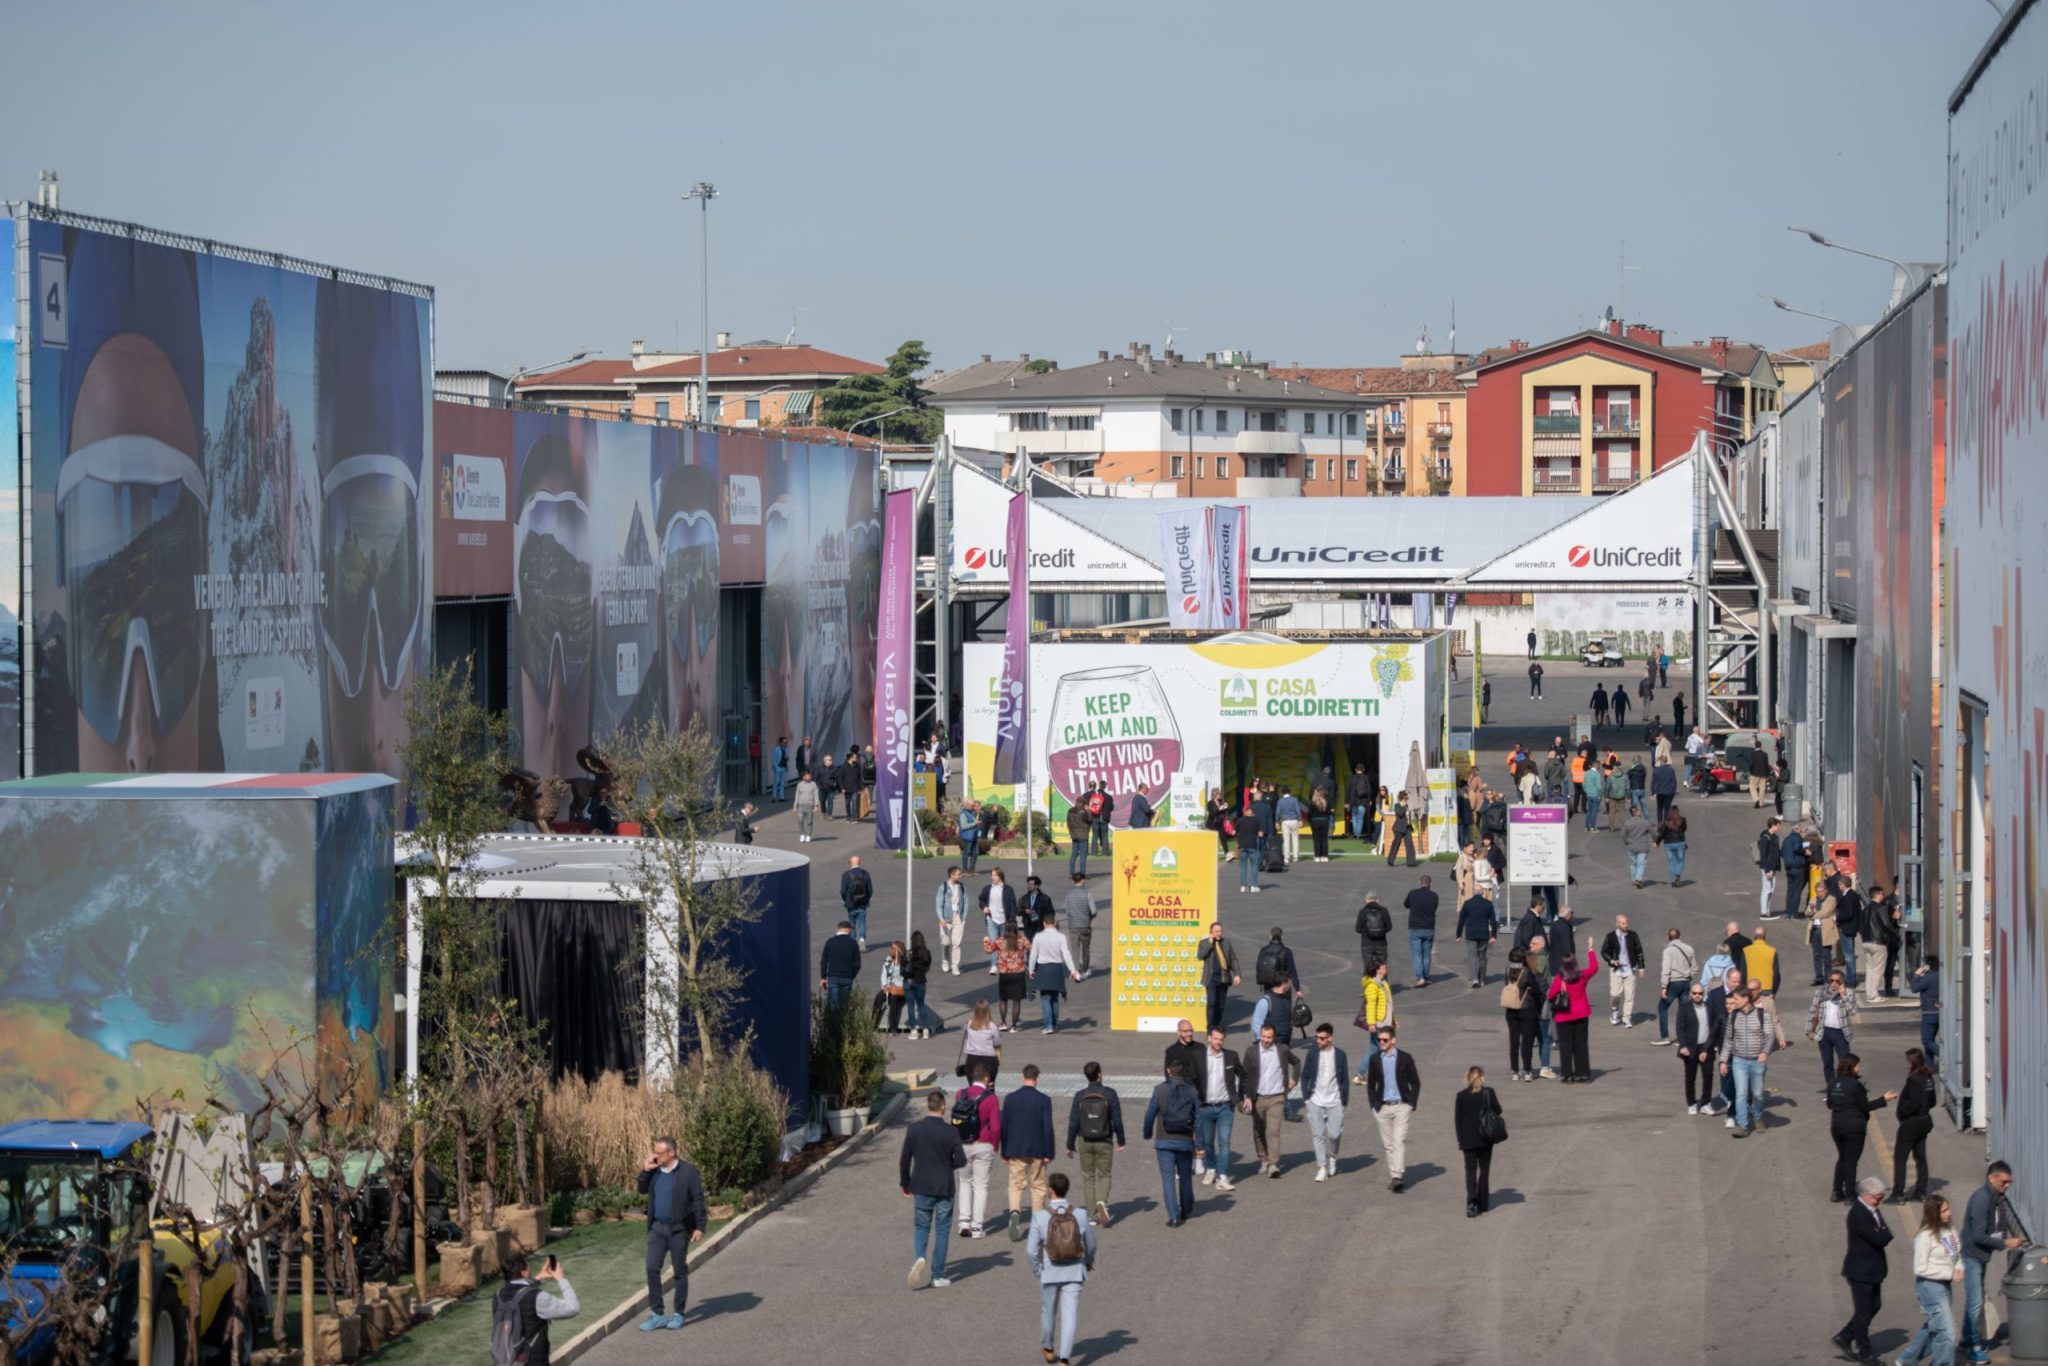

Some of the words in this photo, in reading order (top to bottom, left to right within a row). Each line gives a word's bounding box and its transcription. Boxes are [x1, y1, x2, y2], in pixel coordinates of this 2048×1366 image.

[47, 282, 61, 321] 4
[989, 548, 1076, 568] Uredit
[1222, 523, 1231, 596] UniCredit
[1251, 546, 1444, 563] UniCredit
[1515, 560, 1556, 569] unicredit.it
[1593, 547, 1682, 567] UniCredit
[1087, 561, 1127, 570] unicredit.it
[193, 574, 236, 611] VENETO,
[239, 573, 258, 606] THE
[260, 572, 285, 606] LAND
[287, 571, 299, 605] OF
[302, 571, 329, 608] WINE,
[210, 621, 231, 657] THE
[233, 619, 259, 655] LAND
[263, 618, 274, 654] OF
[1266, 678, 1317, 697] CASA
[1085, 693, 1131, 717] KEEP
[1220, 709, 1258, 717] COLDIRETTI
[1266, 698, 1380, 717] COLDIRETTI
[1064, 718, 1114, 746] CALM
[1120, 716, 1158, 737] AND
[1077, 743, 1113, 769] BEVI
[1115, 743, 1154, 766] VINO
[1068, 759, 1165, 796] ITALIANO
[1148, 895, 1182, 906] CASA
[1129, 907, 1200, 919] COLDIRETTI
